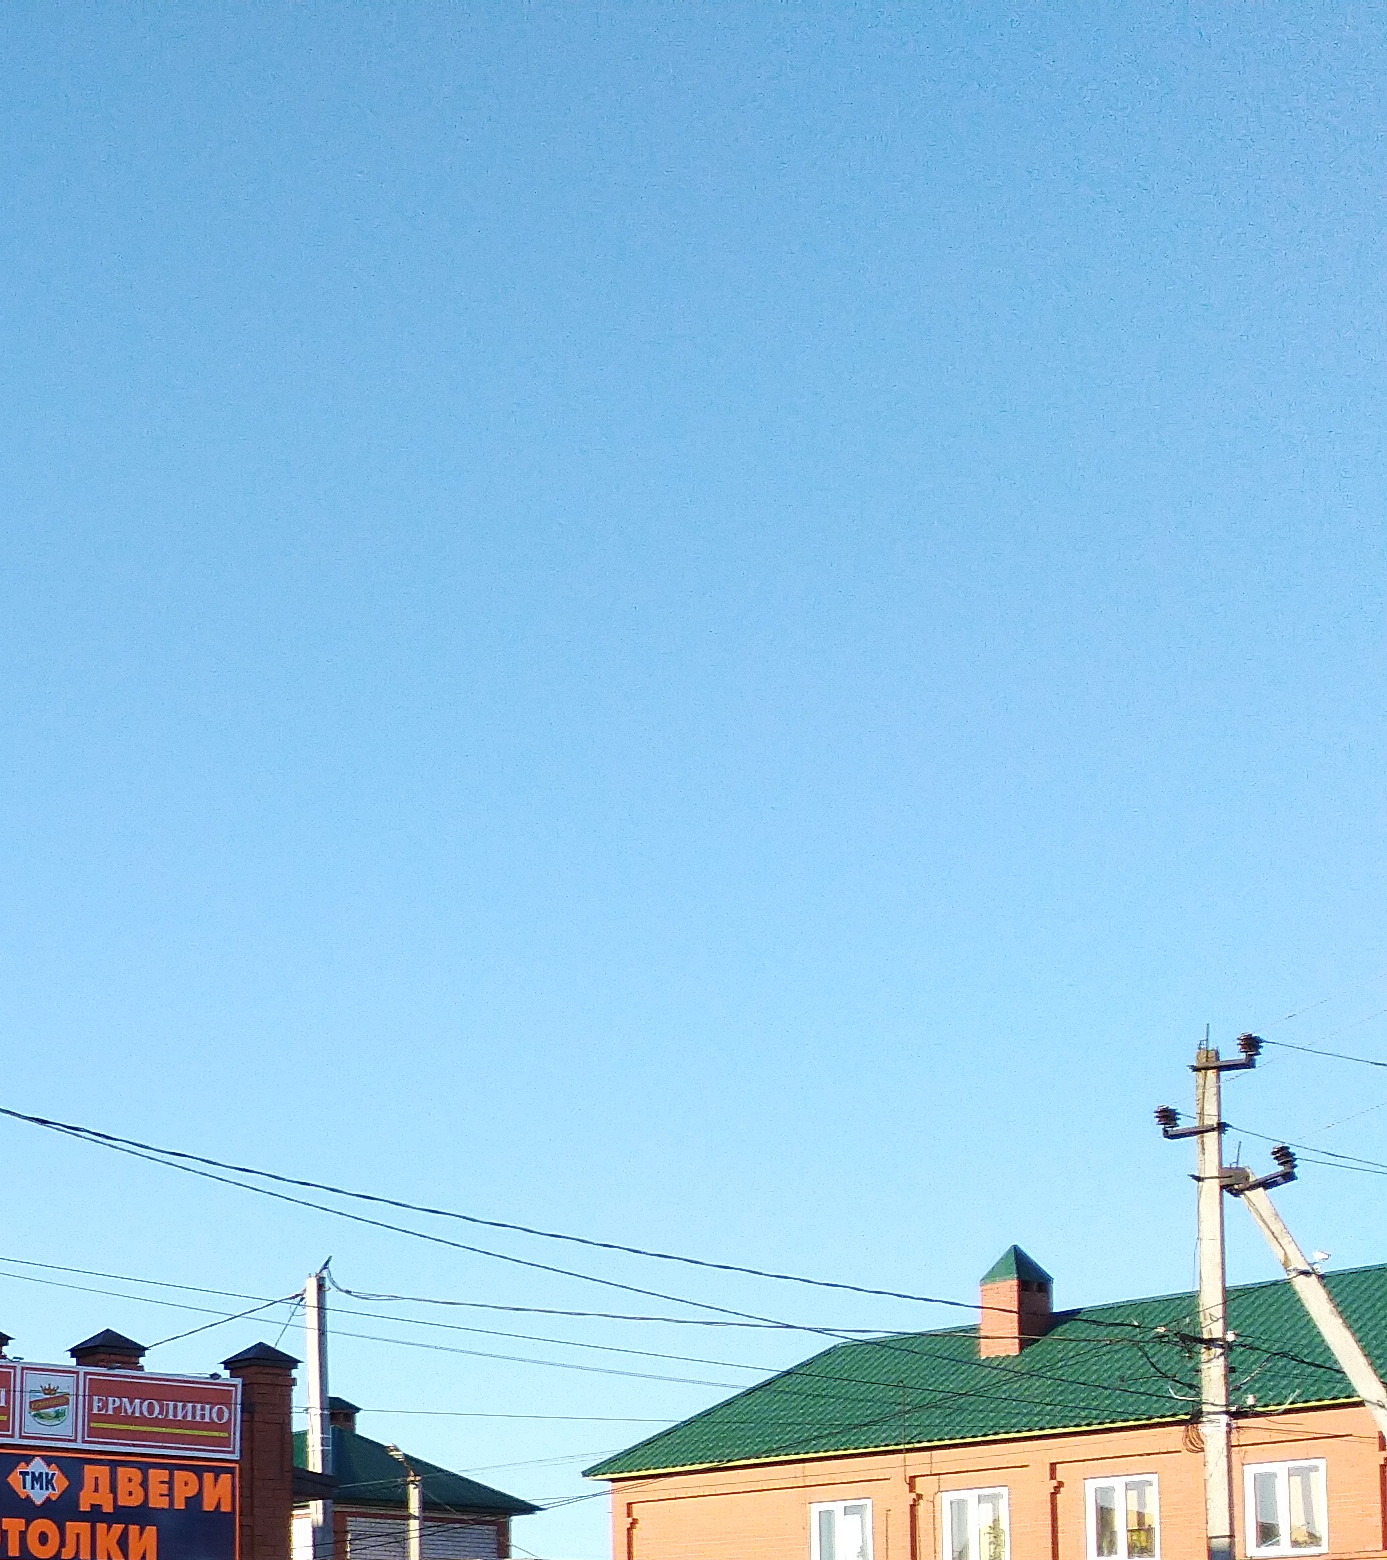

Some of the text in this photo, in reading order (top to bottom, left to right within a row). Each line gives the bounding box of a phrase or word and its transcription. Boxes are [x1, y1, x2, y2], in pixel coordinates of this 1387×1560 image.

[91, 1396, 229, 1425] ЕРМОЛИНО
[18, 1470, 58, 1493] ТМК
[78, 1464, 234, 1513] ДВЕРИ
